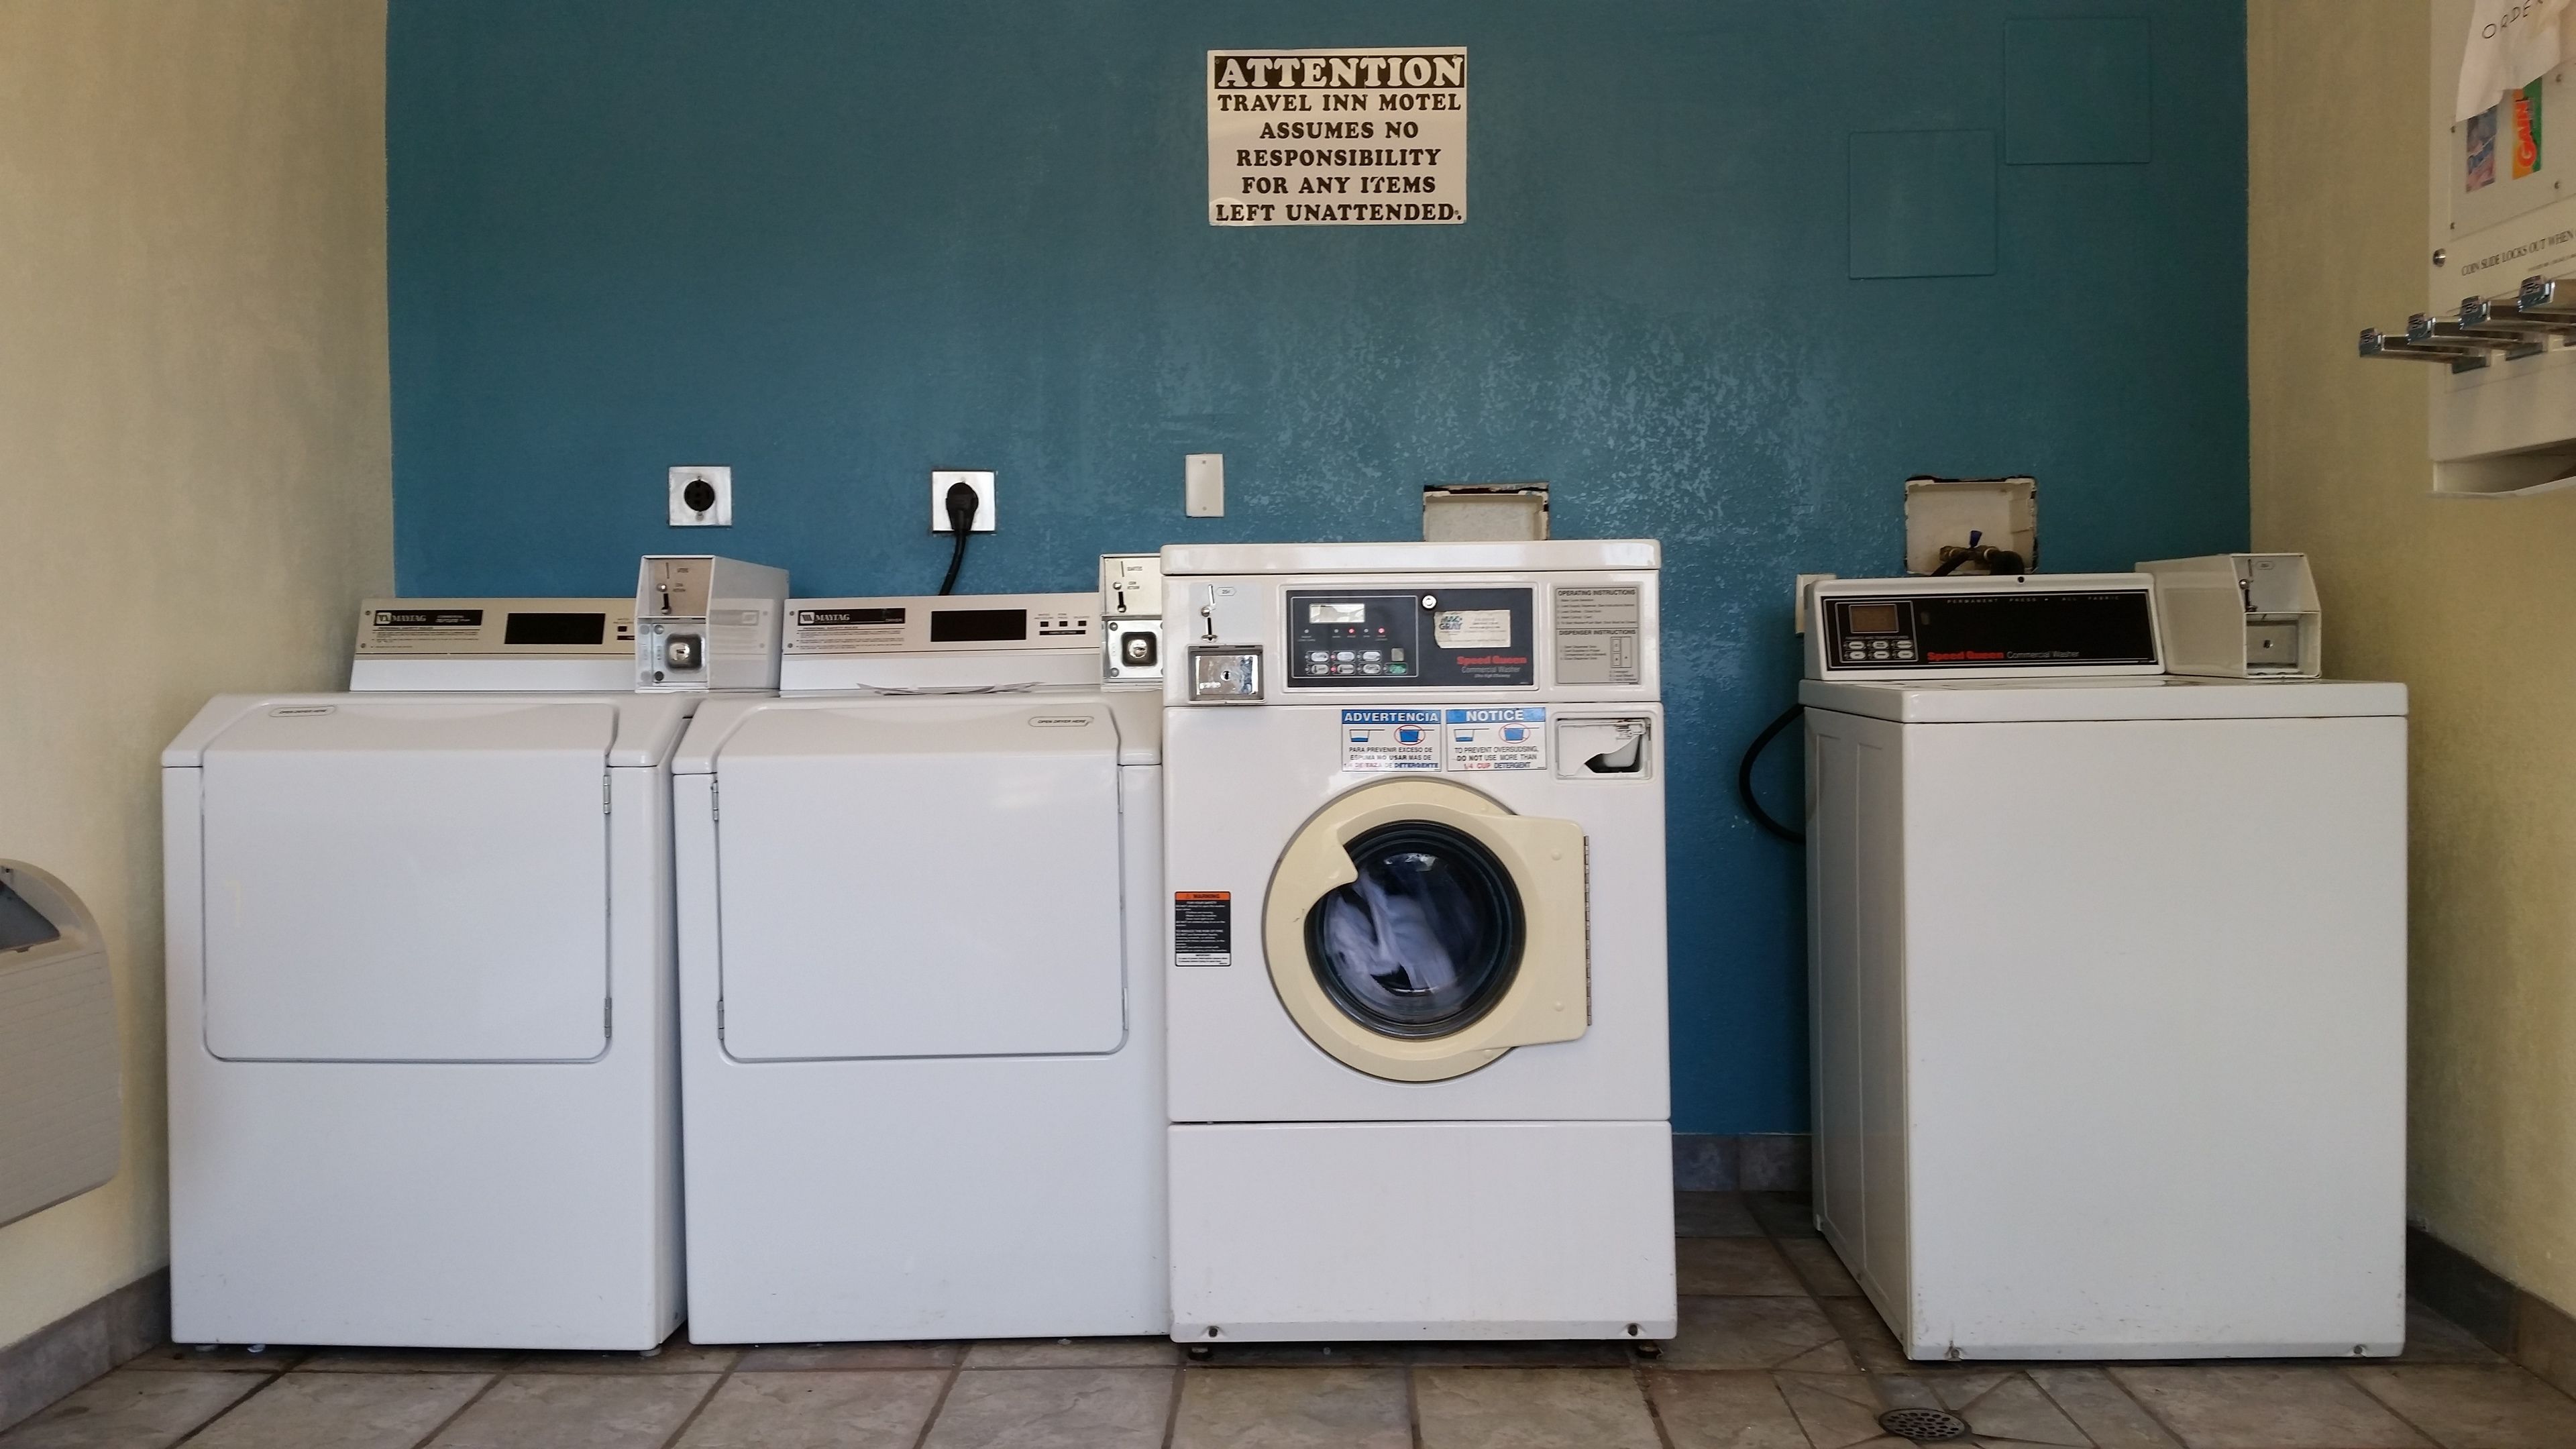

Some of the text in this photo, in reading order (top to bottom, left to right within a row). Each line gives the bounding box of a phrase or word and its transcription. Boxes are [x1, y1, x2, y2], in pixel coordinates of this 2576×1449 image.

[1218, 56, 1463, 87] ATTENTION
[1218, 93, 1461, 111] TRAVEL INN MOTEL
[1259, 121, 1418, 139] ASSUMES NO
[1236, 149, 1441, 166] RESPONSIBILITY
[1242, 176, 1436, 194] FOR ANY ITEMS
[1216, 204, 1462, 221] LEFT UNATTENDED.
[2481, 254, 2500, 270] SLIDE
[2502, 248, 2528, 263] LOCKS
[2528, 238, 2546, 254] OUT
[2548, 230, 2574, 246] WHEN
[1456, 655, 1527, 665] Speed Queen
[1927, 651, 1965, 661] Speed
[1966, 651, 2004, 659] Queen
[2006, 651, 2050, 659] Commercial
[1344, 712, 1439, 722] ADVERTENCIA
[1466, 710, 1525, 722] NOTICE
